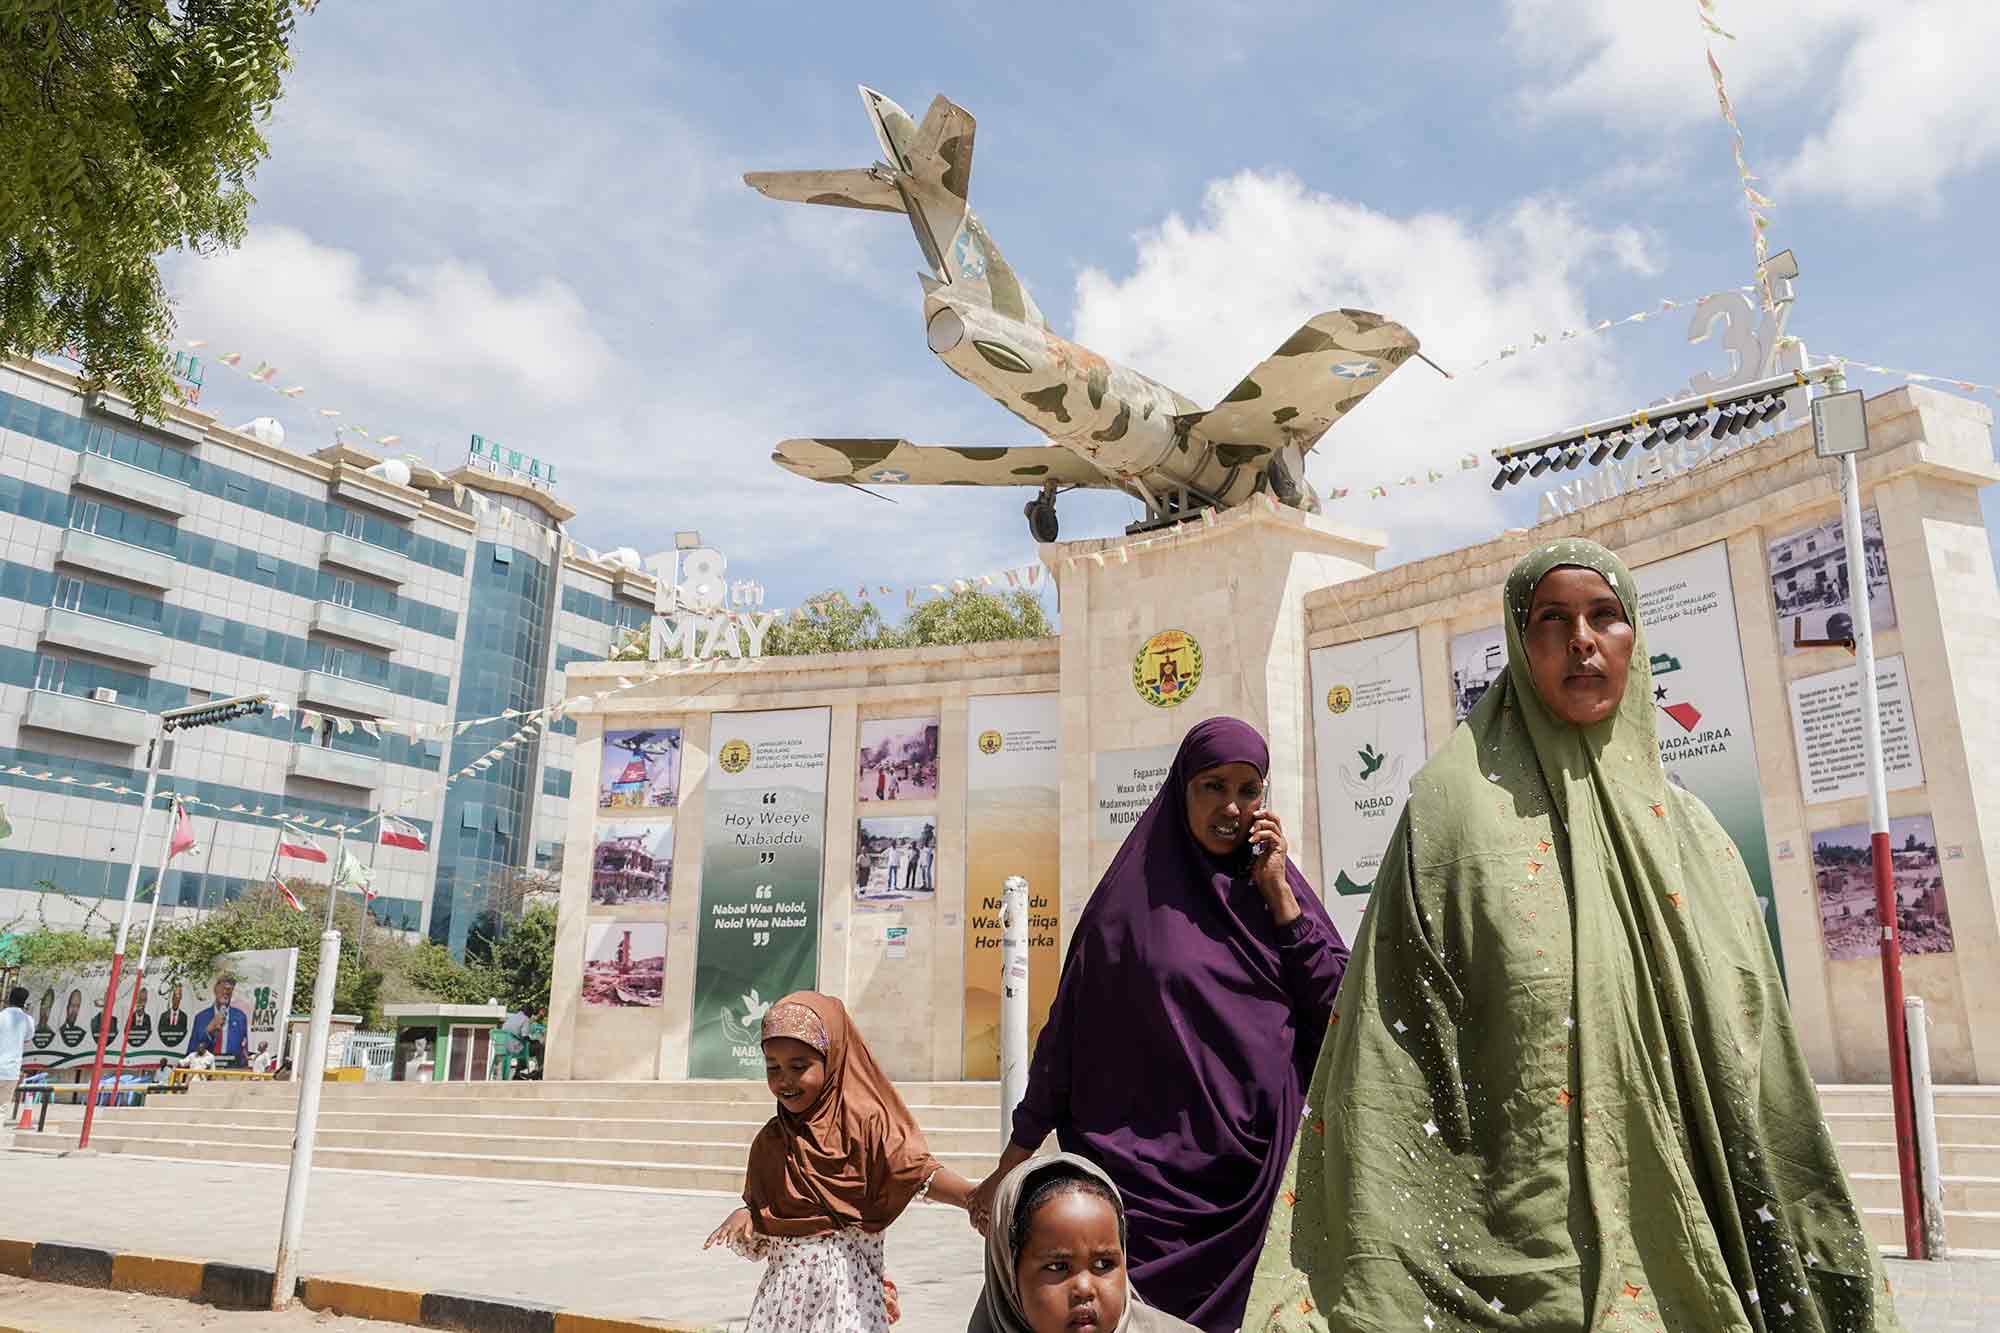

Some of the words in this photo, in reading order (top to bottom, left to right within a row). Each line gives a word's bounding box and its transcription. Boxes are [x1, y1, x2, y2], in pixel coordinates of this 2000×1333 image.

[648, 613, 774, 662] MAY
[1661, 752, 1677, 763] GU
[1679, 742, 1727, 761] HANTAA
[1117, 783, 1135, 793] Waxa
[1136, 783, 1147, 792] dib
[1354, 796, 1394, 811] NABAD
[1110, 810, 1145, 825] MUDAN
[1362, 809, 1385, 817] PEACE
[725, 813, 754, 829] Hoy
[760, 812, 810, 827] Weeye
[735, 831, 802, 845] Nabaddu
[1356, 859, 1381, 869] SOMAL
[712, 904, 748, 915] Nabad
[750, 903, 772, 913] Waa
[775, 902, 807, 914] Nolol,
[982, 896, 1048, 911] Nadu
[715, 918, 744, 929] Nolol
[746, 919, 769, 928] Waa
[771, 916, 807, 928] Nabad
[975, 935, 1054, 949] Horrka
[252, 1009, 279, 1025] MAY
